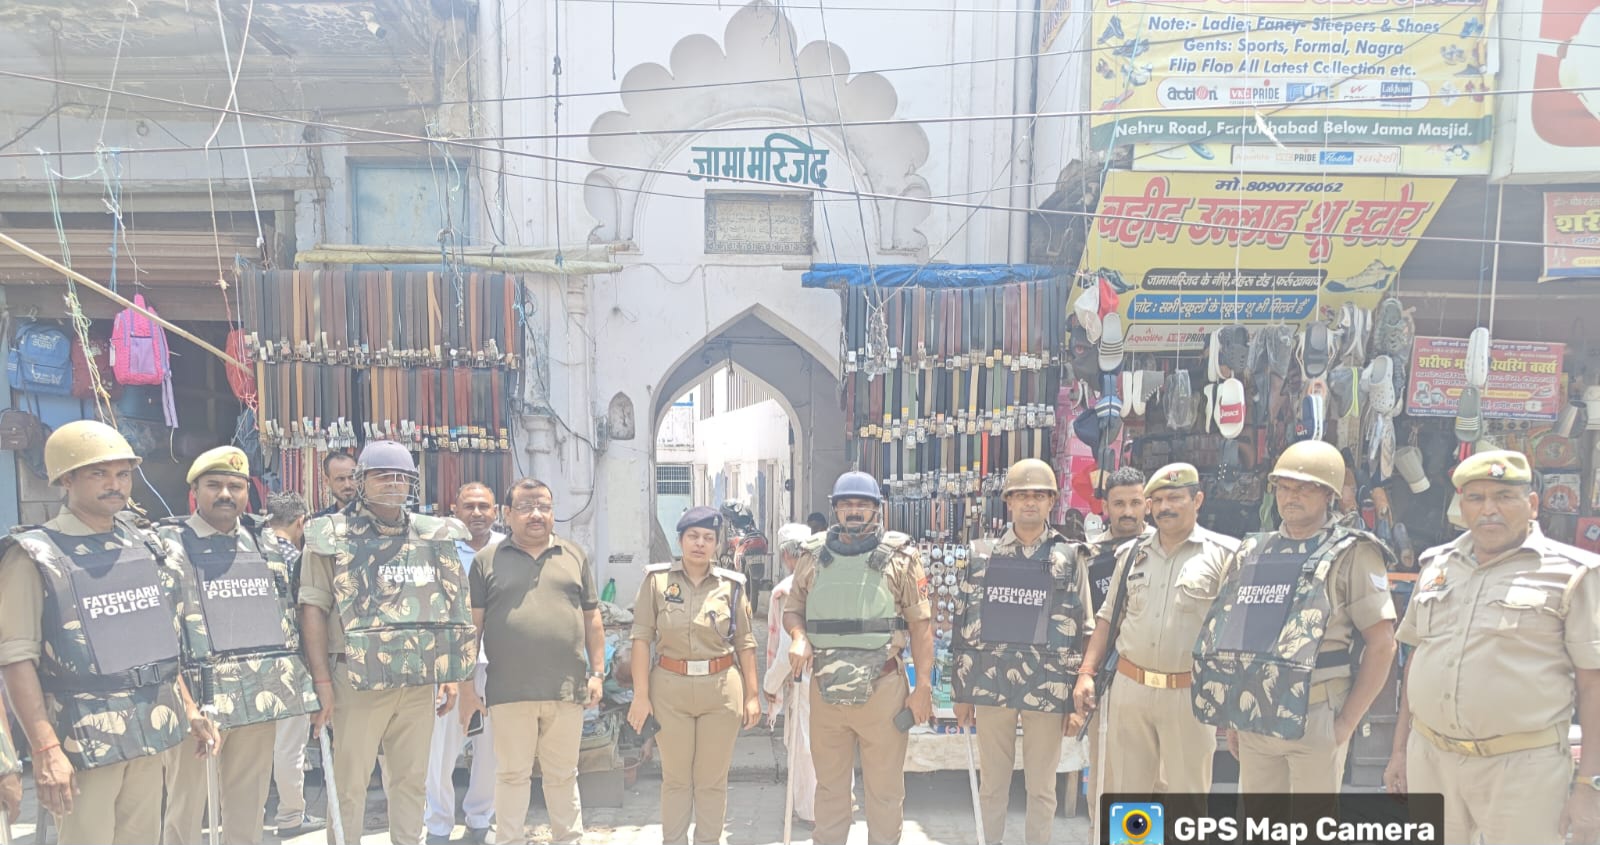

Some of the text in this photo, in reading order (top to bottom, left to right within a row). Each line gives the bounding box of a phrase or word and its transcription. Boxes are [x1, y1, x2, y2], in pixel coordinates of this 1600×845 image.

[1398, 18, 1440, 33] Shoes
[1184, 38, 1404, 58] Gents: Sports, Formal, Nagra
[1169, 58, 1196, 73] Flip
[1201, 58, 1234, 73] Flop
[1238, 59, 1259, 73] All
[1264, 60, 1308, 74] Latest
[1390, 63, 1416, 76] etc.
[1253, 87, 1280, 99] PRIDE
[1115, 120, 1472, 139] Nehru Road, Farruhabad Below Jama Masjid.
[1097, 176, 1432, 264] वहीद उल्लाह शू स्टोर
[202, 577, 270, 592] FATEHGARH
[1237, 584, 1291, 596] FATEHGARH
[83, 584, 161, 611] FATEHGARH
[207, 587, 269, 600] POLICE
[986, 586, 1047, 599] FATEHGARH
[1236, 594, 1285, 605] POLICE
[89, 596, 161, 620] POLICE
[988, 595, 1046, 607] POLICE
